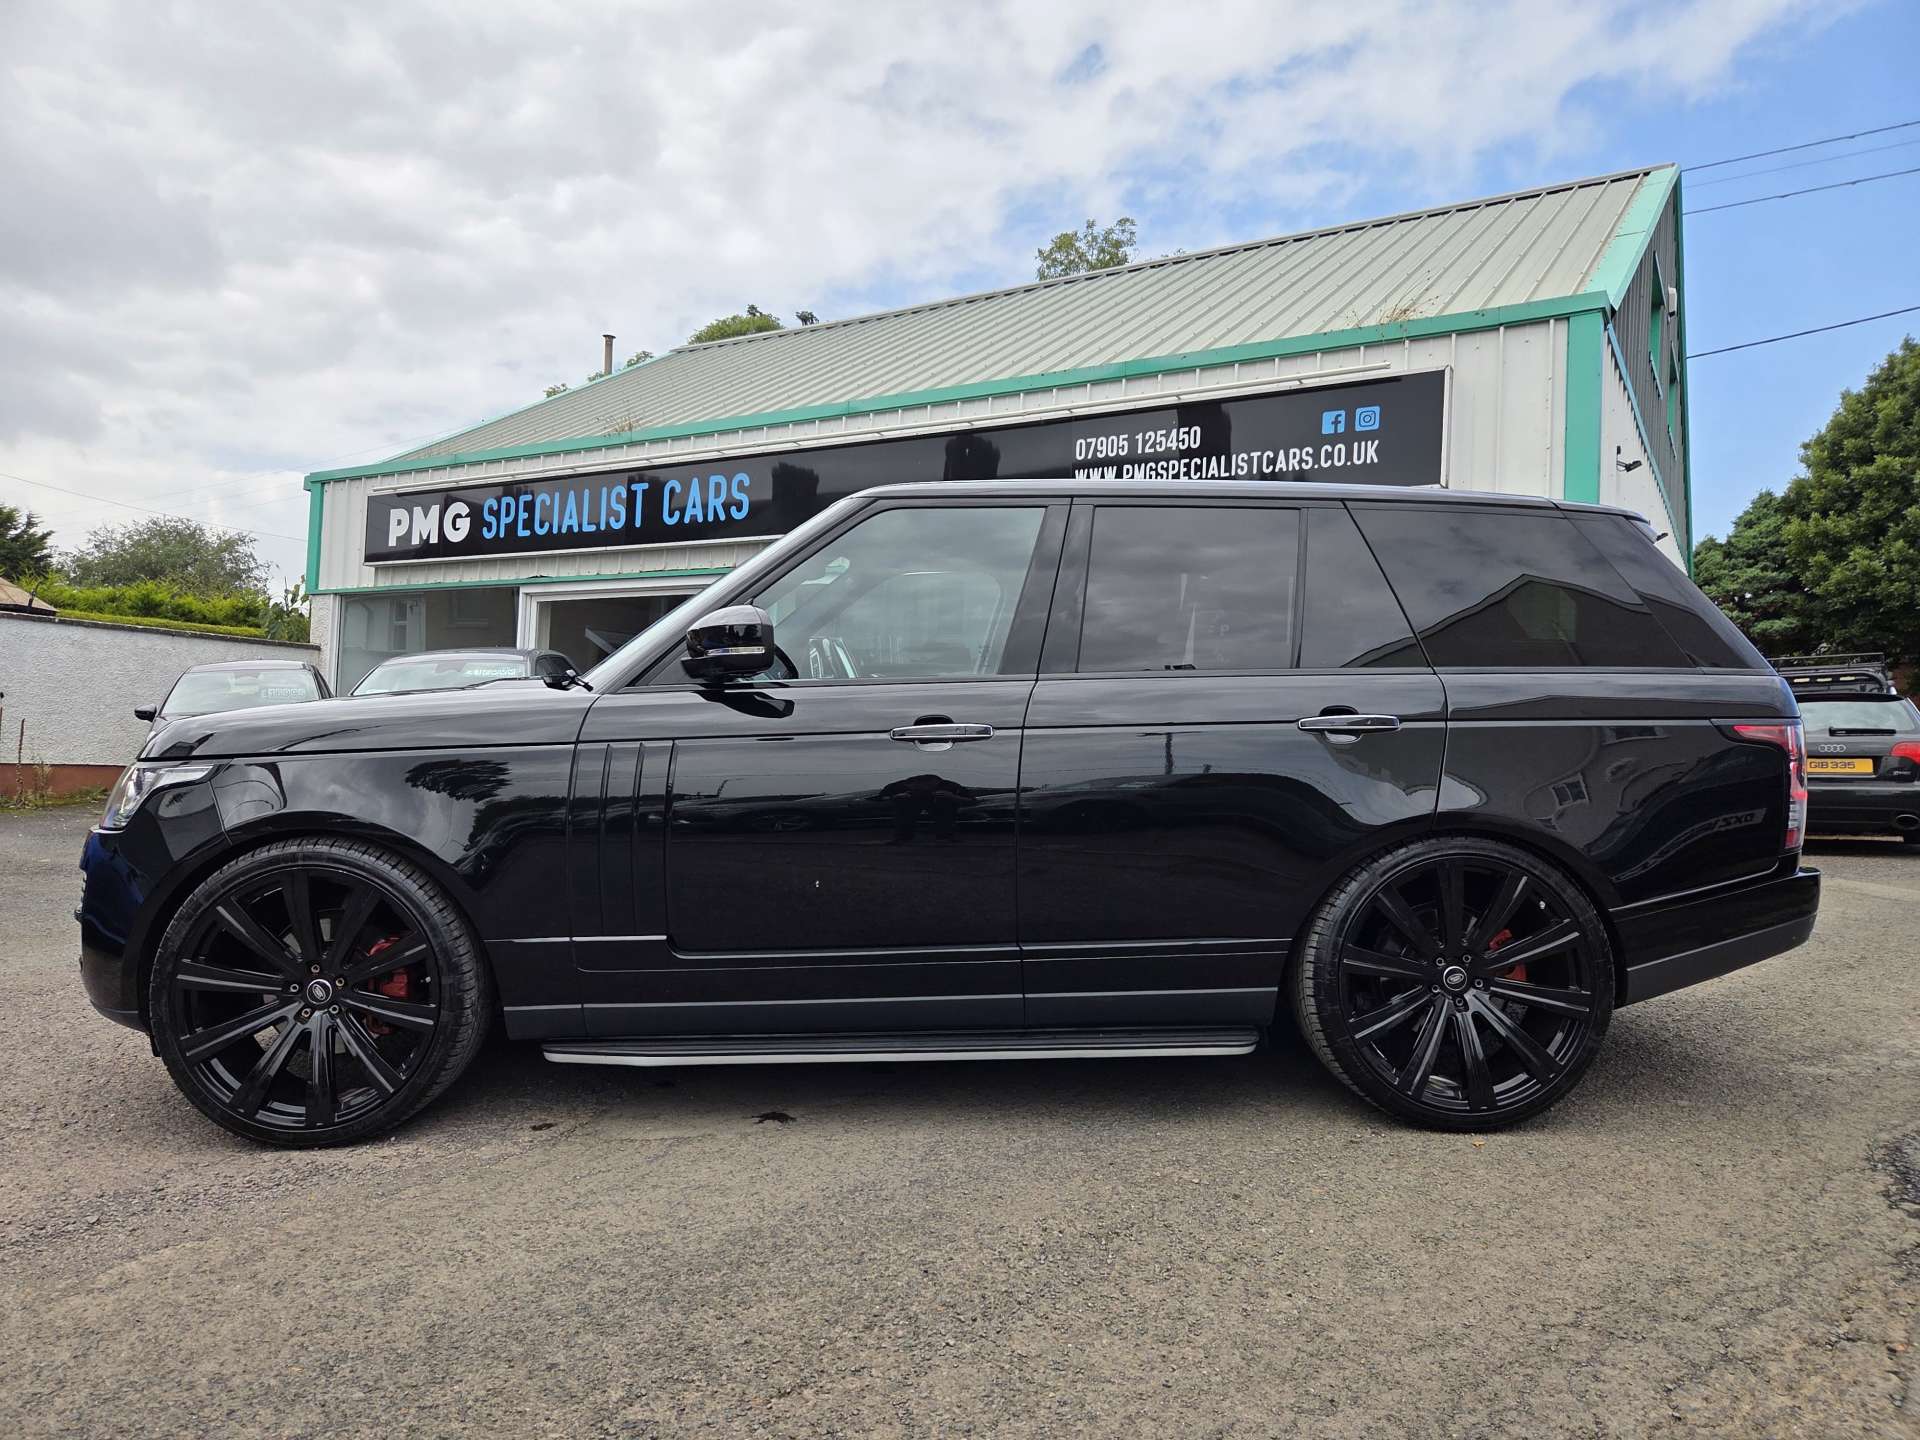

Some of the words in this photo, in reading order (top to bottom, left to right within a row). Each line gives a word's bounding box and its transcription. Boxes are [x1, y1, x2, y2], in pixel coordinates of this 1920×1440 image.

[1074, 439, 1379, 480] WWWPMGSPECIALISTCARS.CO.UK
[1075, 435, 1129, 461] 07905
[1135, 421, 1201, 455] 125450
[387, 501, 471, 547] PMG
[482, 482, 649, 540] SPECIALIST
[662, 472, 751, 526] CARS
